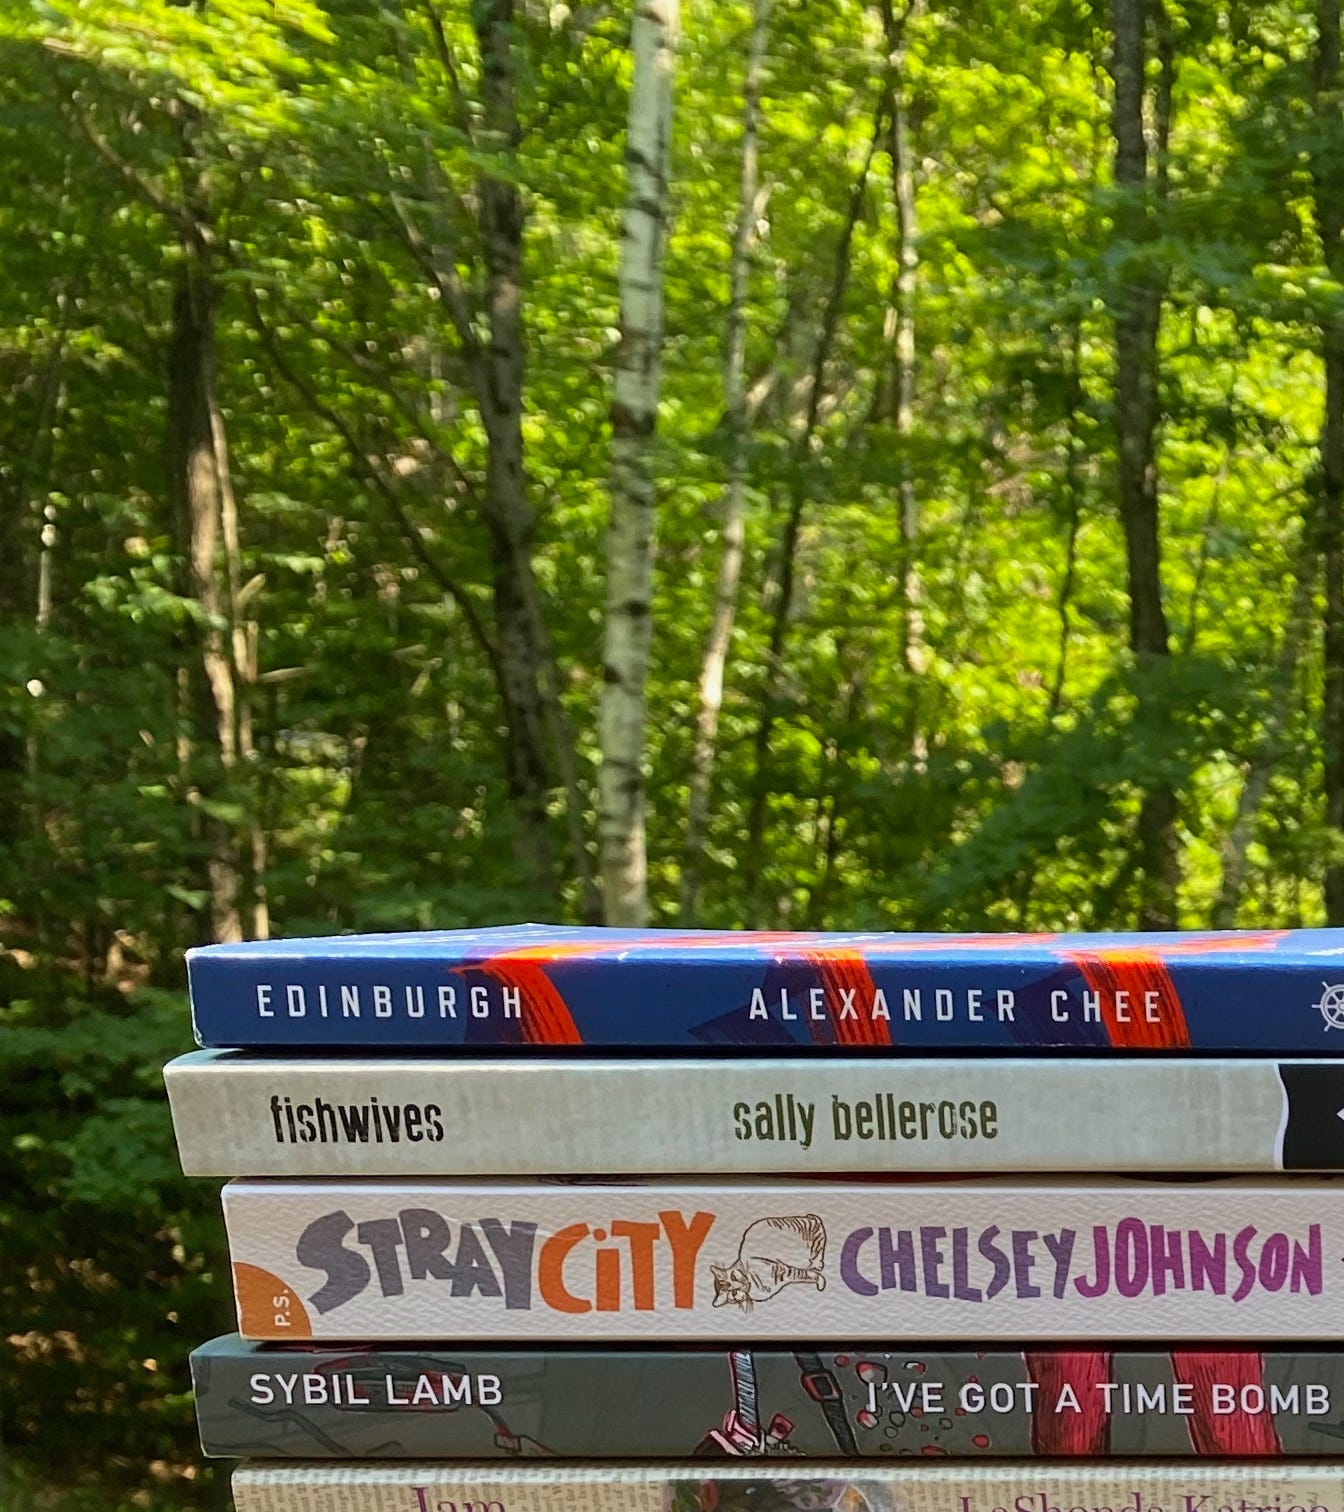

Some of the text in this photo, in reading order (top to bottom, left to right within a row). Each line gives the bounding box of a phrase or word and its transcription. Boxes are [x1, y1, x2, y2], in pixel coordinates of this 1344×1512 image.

[257, 984, 523, 1020] EDINBURGH
[749, 988, 1161, 1024] ALEXANDER CHEE
[270, 1095, 444, 1144] fishwives
[733, 1093, 999, 1150] sally bellerose
[249, 1373, 503, 1405] SYBIL LAMB
[961, 1381, 1039, 1413] GOT
[1054, 1383, 1081, 1413] A
[1096, 1382, 1196, 1414] TIME
[1211, 1382, 1331, 1414] BOMB
